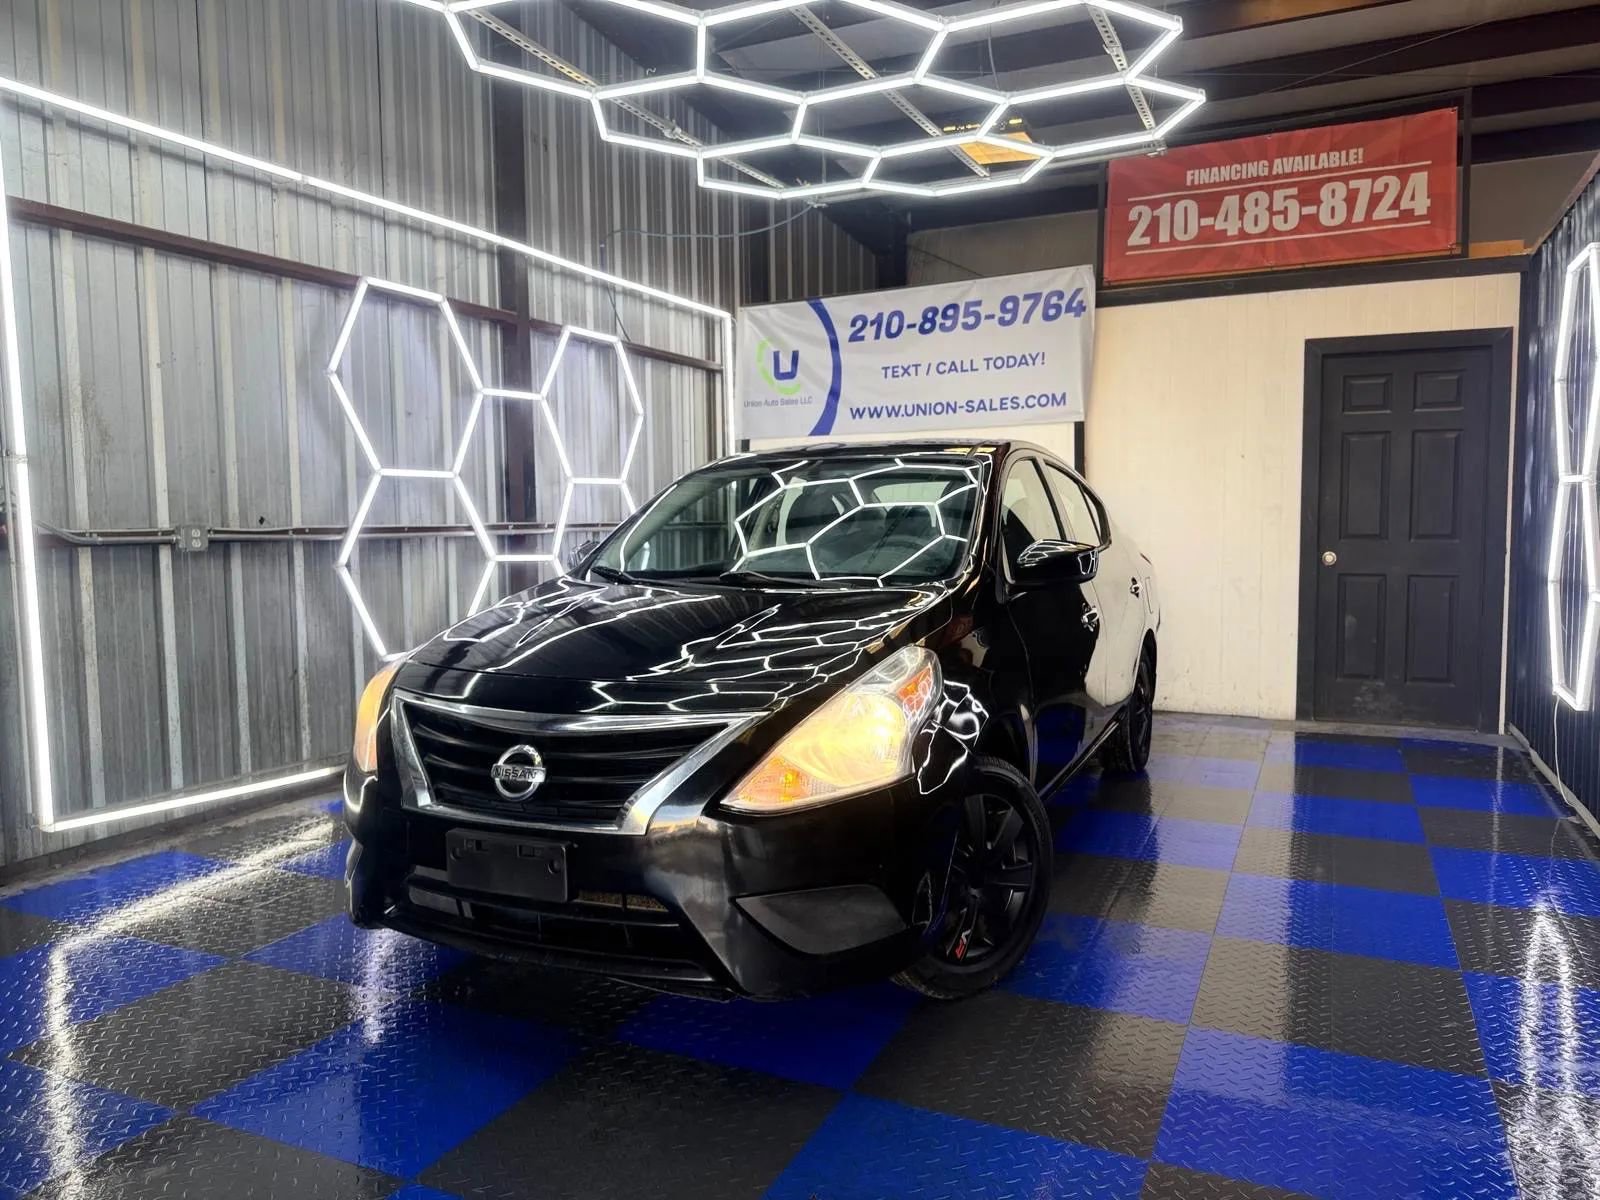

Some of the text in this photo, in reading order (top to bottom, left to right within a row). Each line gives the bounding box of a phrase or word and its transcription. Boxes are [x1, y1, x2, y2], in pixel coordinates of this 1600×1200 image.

[1186, 147, 1364, 186] FINANCING AVAILABLE!
[1127, 172, 1431, 246] 210-485-8724
[848, 287, 1086, 342] 210-895-9764
[881, 363, 922, 379] TEXT
[935, 359, 979, 375] CALL
[984, 352, 1046, 370] TODAY!
[743, 396, 813, 408] Union Auto Sales LLC
[849, 392, 1067, 420] WWW.UNION-SALES.COM
[494, 766, 537, 780] NISSAN
